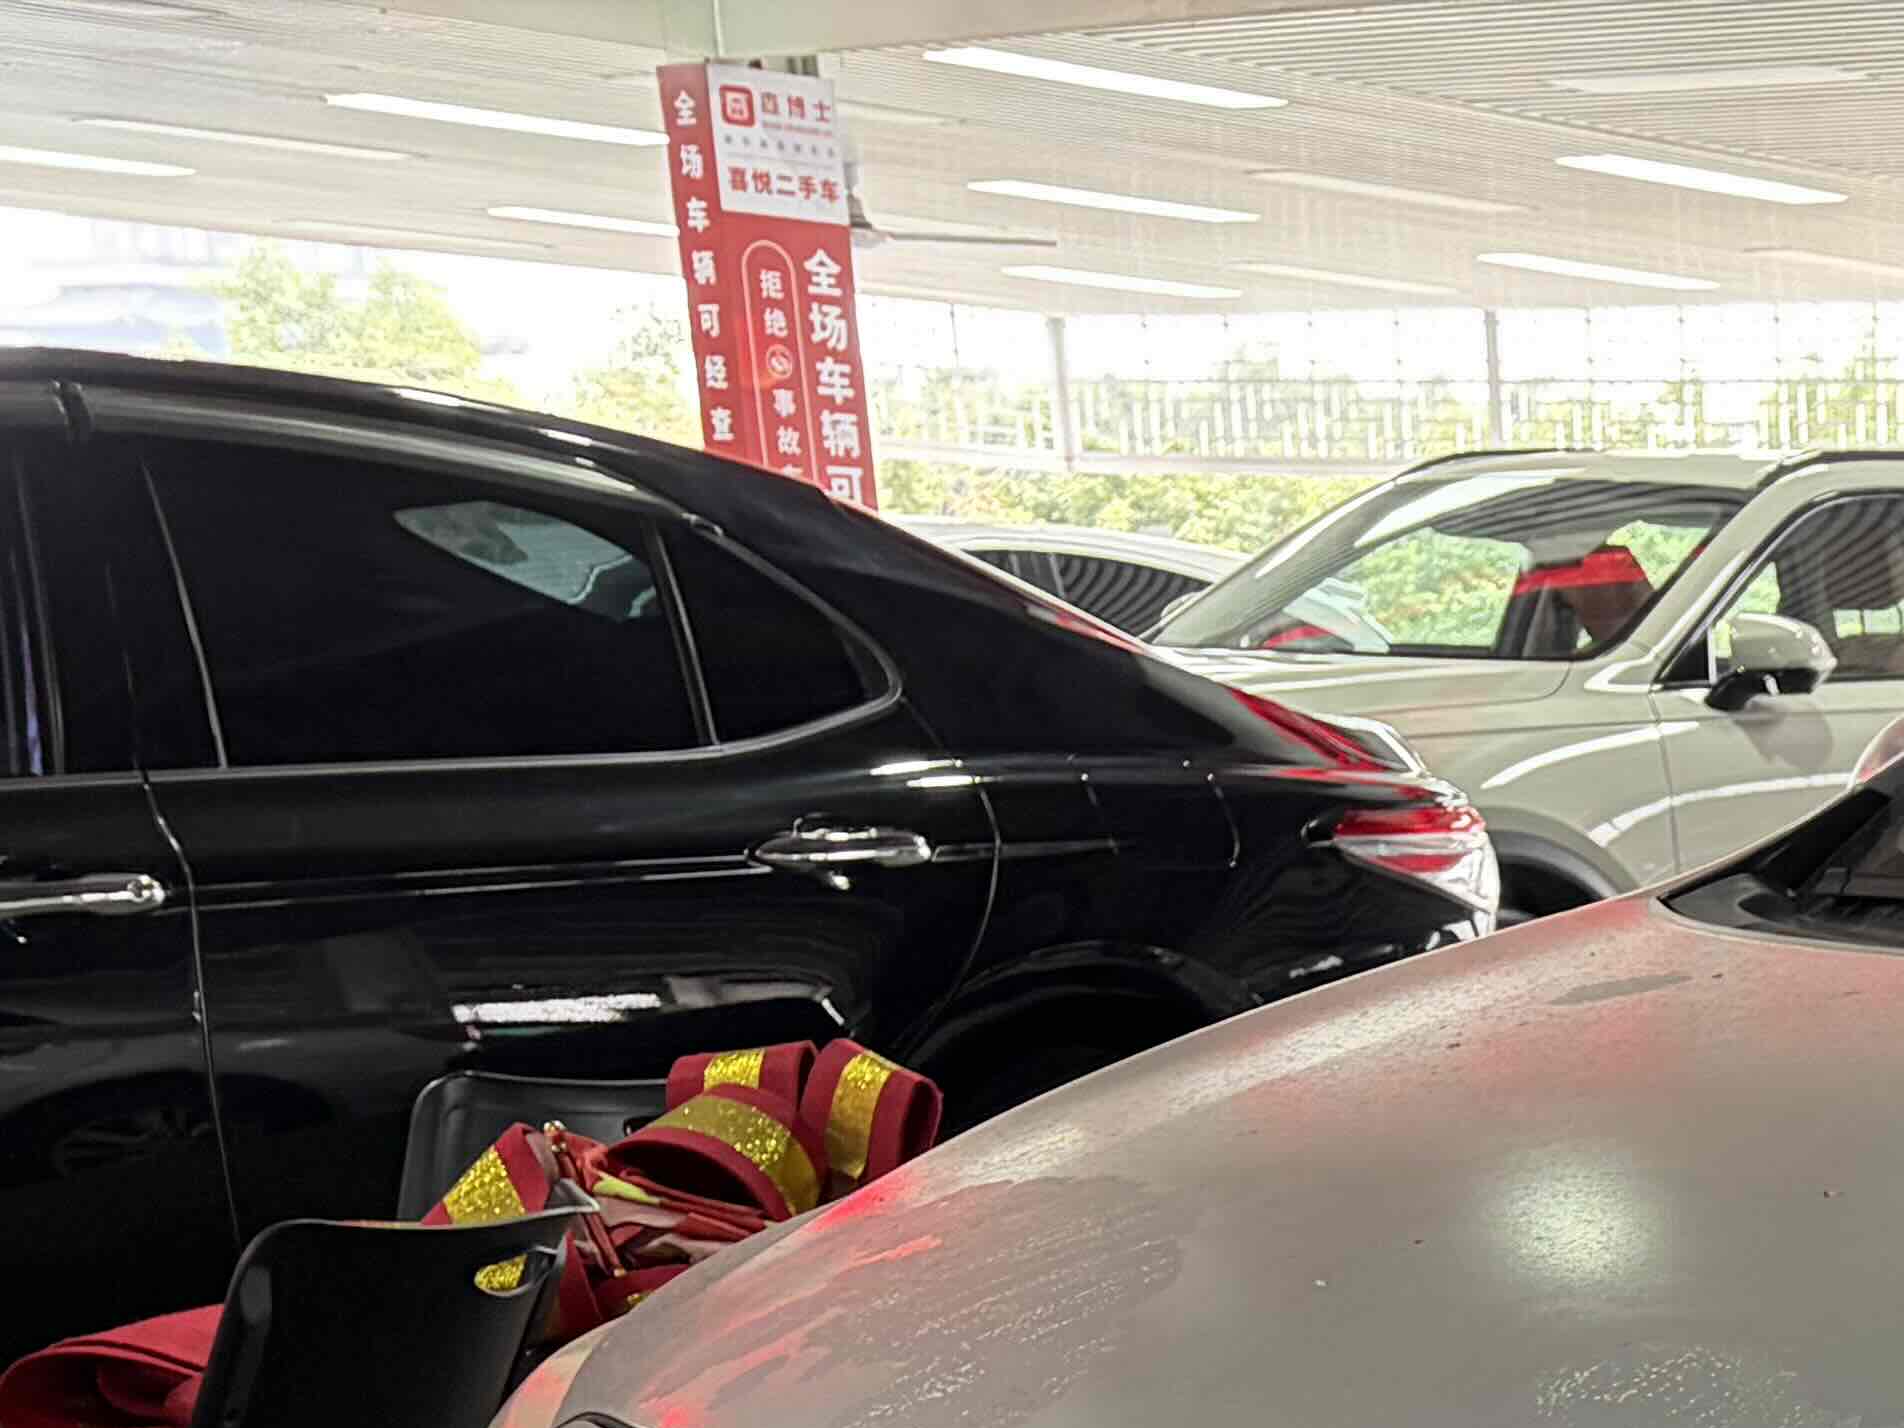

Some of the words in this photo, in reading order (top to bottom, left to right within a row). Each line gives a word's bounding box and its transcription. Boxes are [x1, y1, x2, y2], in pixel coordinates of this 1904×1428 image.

[672, 89, 736, 442] 全场车辆可经查
[728, 166, 841, 203] 喜悦二手车
[803, 248, 864, 505] 全场车辆可
